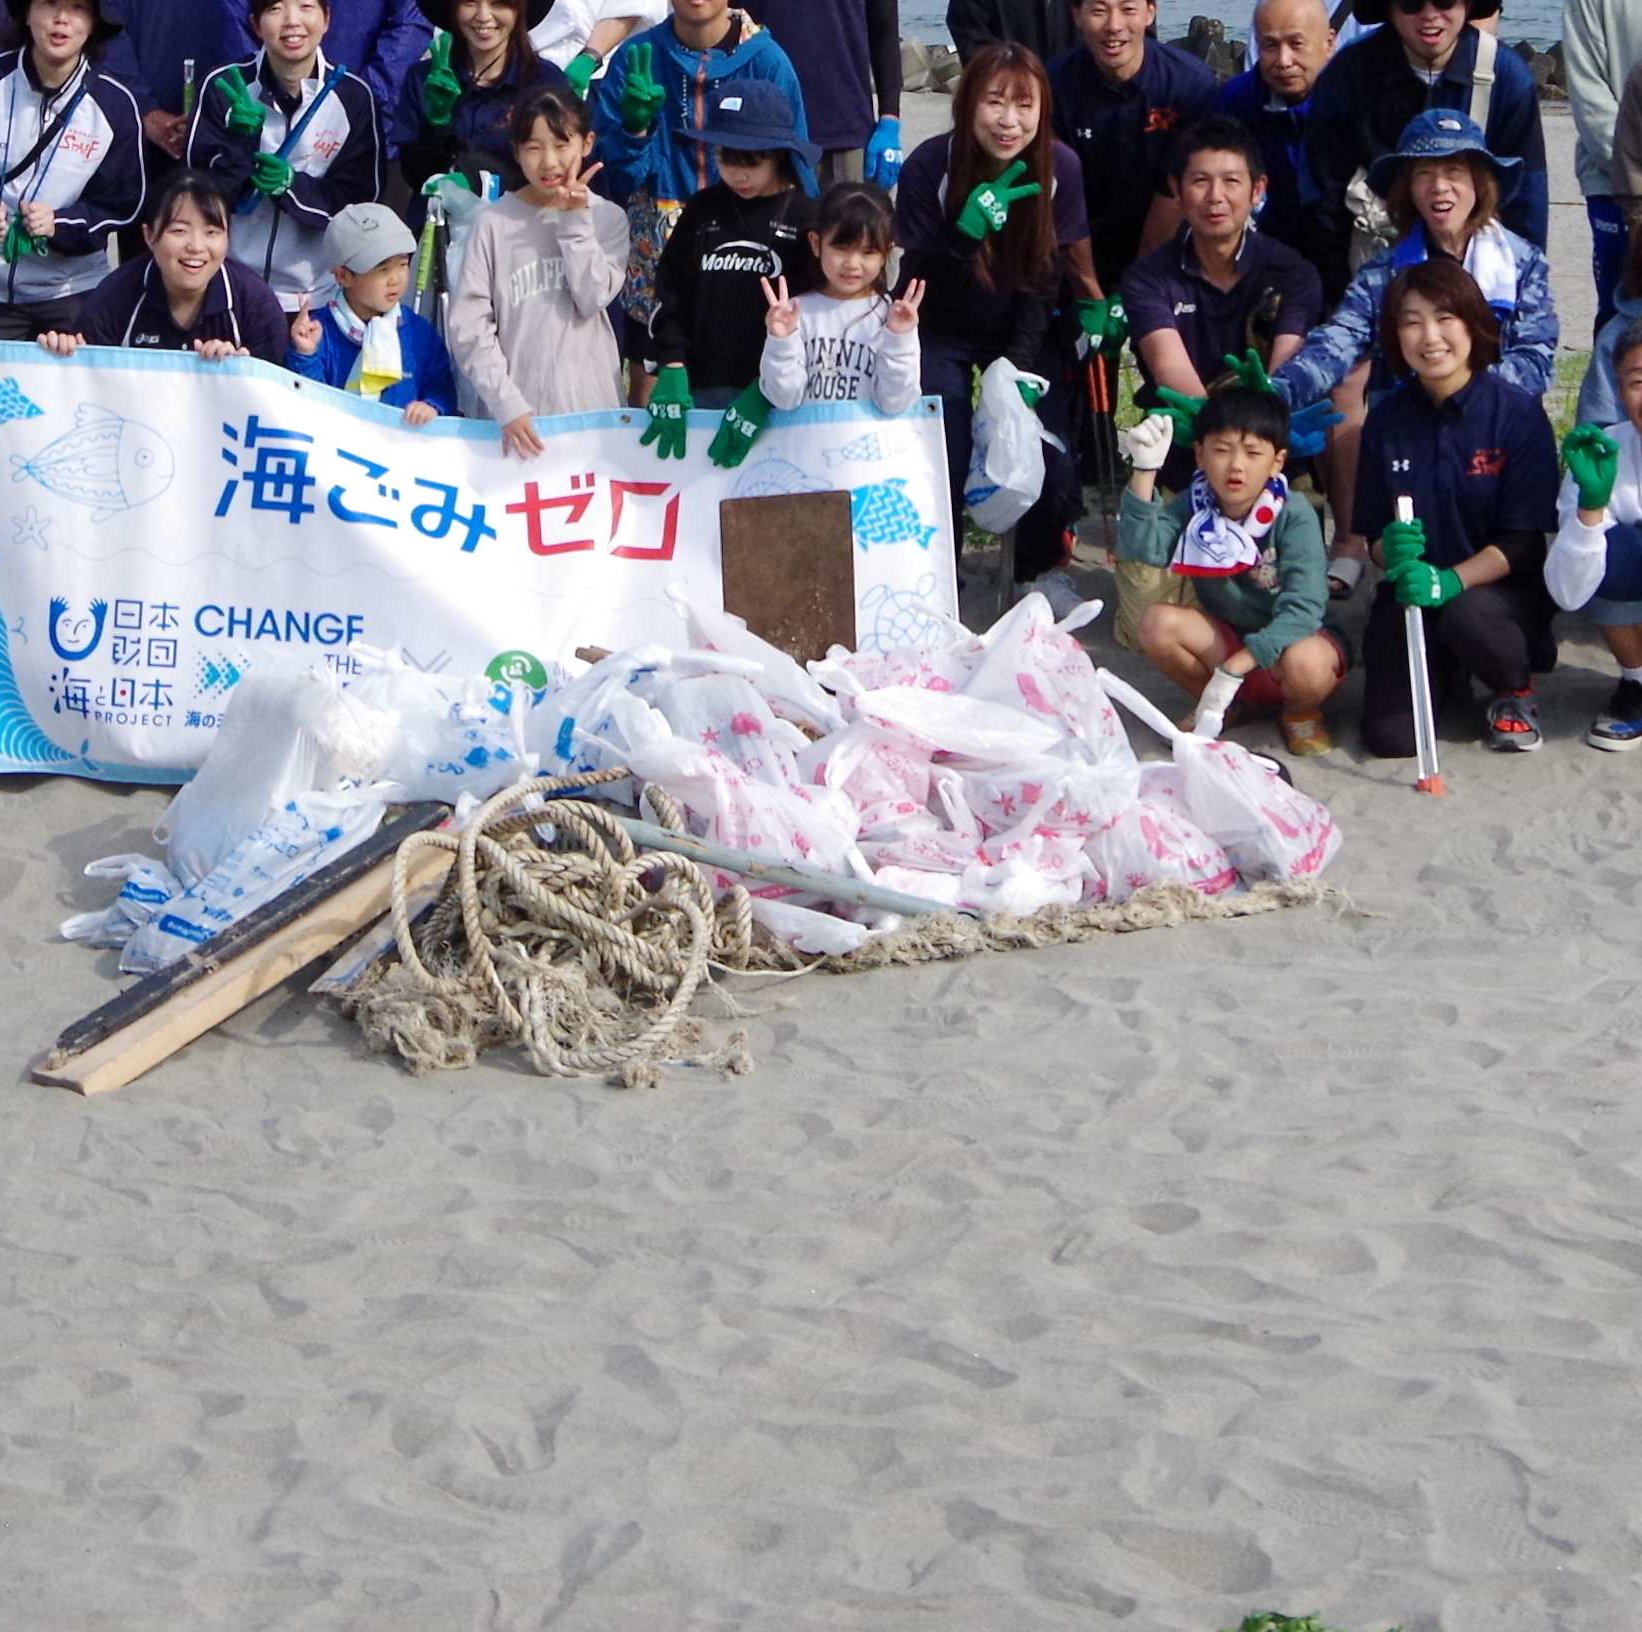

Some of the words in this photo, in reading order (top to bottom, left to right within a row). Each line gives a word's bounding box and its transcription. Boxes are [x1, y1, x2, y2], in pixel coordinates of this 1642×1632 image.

[214, 413, 682, 563] 海ごみゼロ
[114, 599, 179, 631] 日本
[112, 636, 177, 668] 財団
[49, 668, 173, 720] 海と日本
[94, 711, 171, 729] PROJECT
